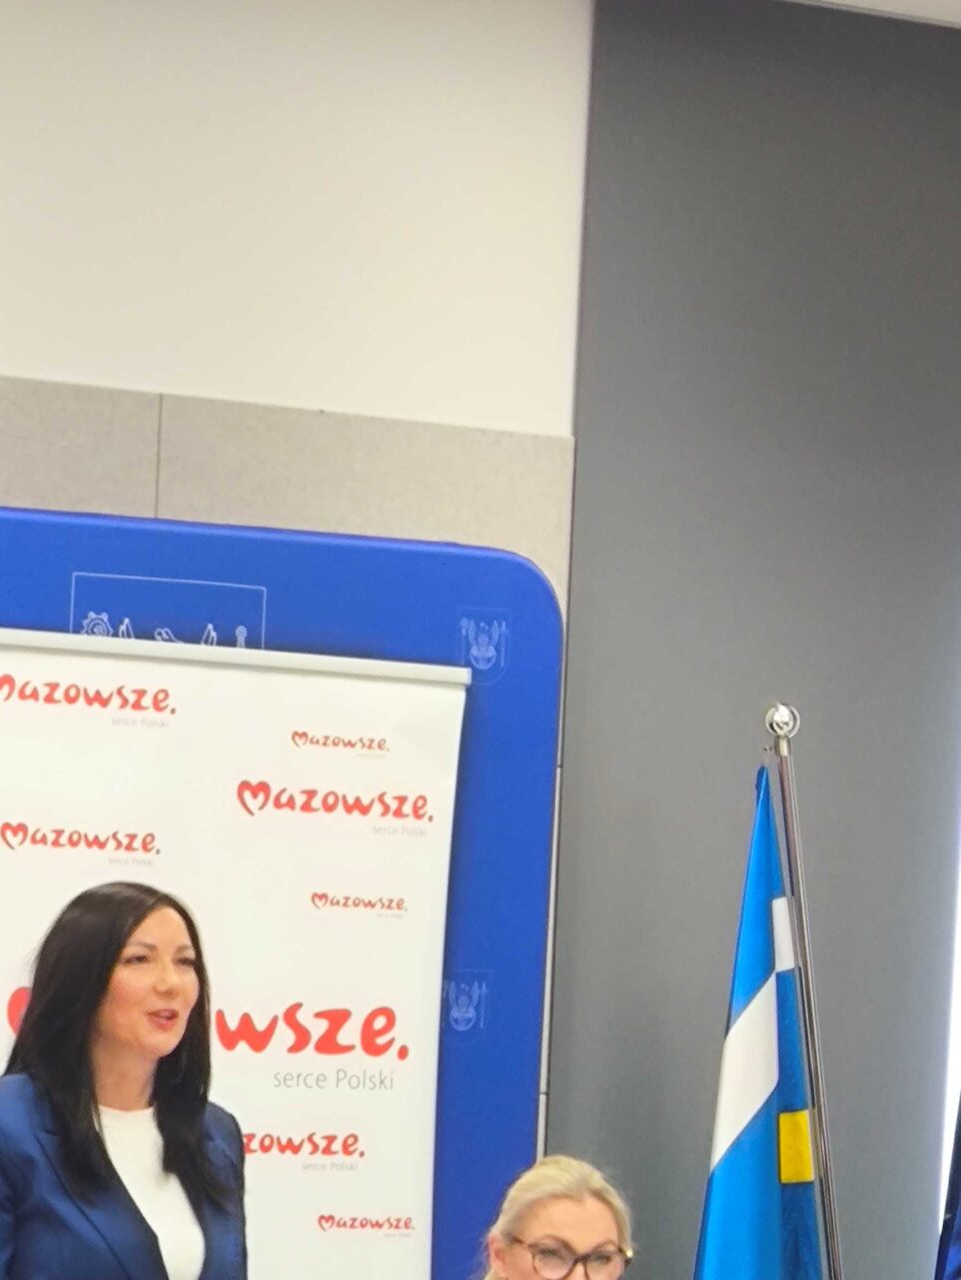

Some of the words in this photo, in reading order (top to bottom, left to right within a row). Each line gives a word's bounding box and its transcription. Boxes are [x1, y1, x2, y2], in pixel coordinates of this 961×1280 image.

[236, 780, 434, 823] Mazowsze.
[0, 822, 161, 855] Mazowsze.
[215, 1002, 409, 1061] wsze.
[273, 1071, 328, 1089] serce
[336, 1068, 395, 1090] Polski
[242, 1132, 366, 1158] zowsze.
